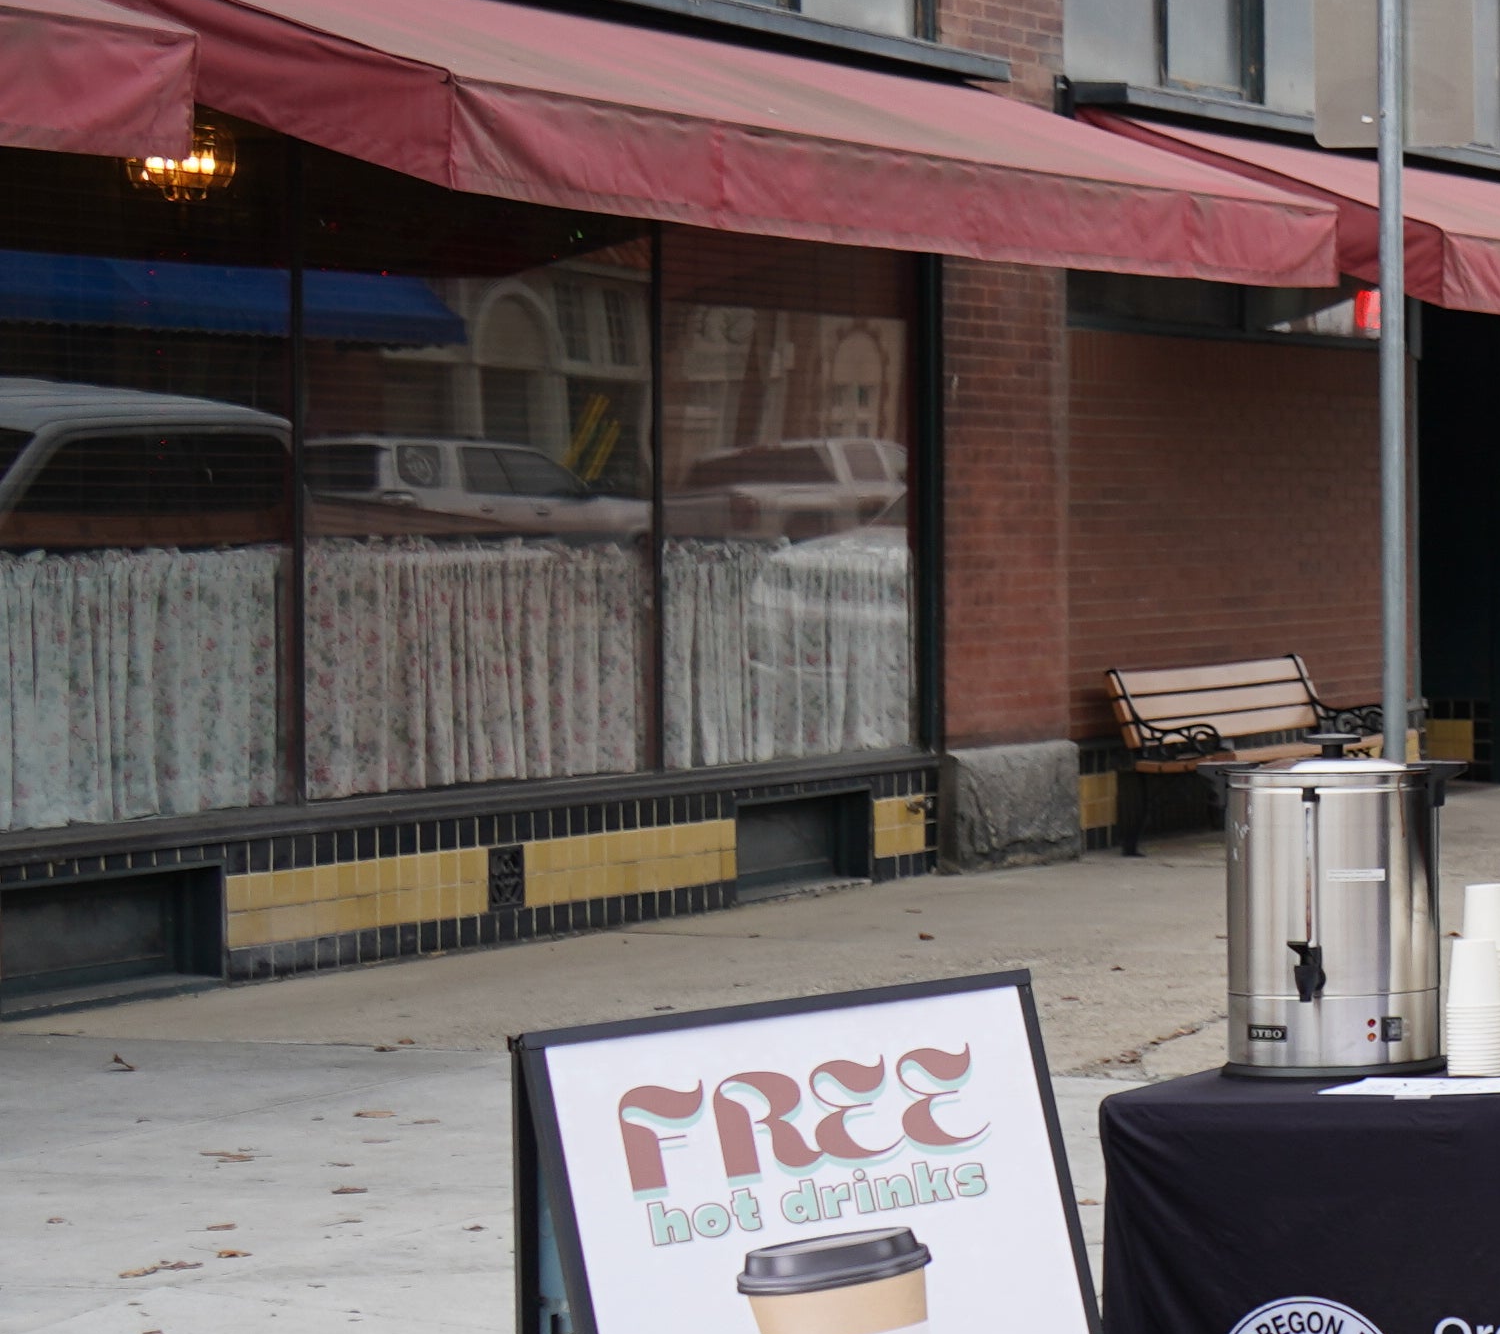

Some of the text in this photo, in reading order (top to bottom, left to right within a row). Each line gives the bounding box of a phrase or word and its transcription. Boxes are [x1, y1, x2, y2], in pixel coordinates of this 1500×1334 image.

[1250, 1028, 1283, 1039] SYBO
[618, 1042, 992, 1201] FREE
[646, 1160, 989, 1247] hot drinks
